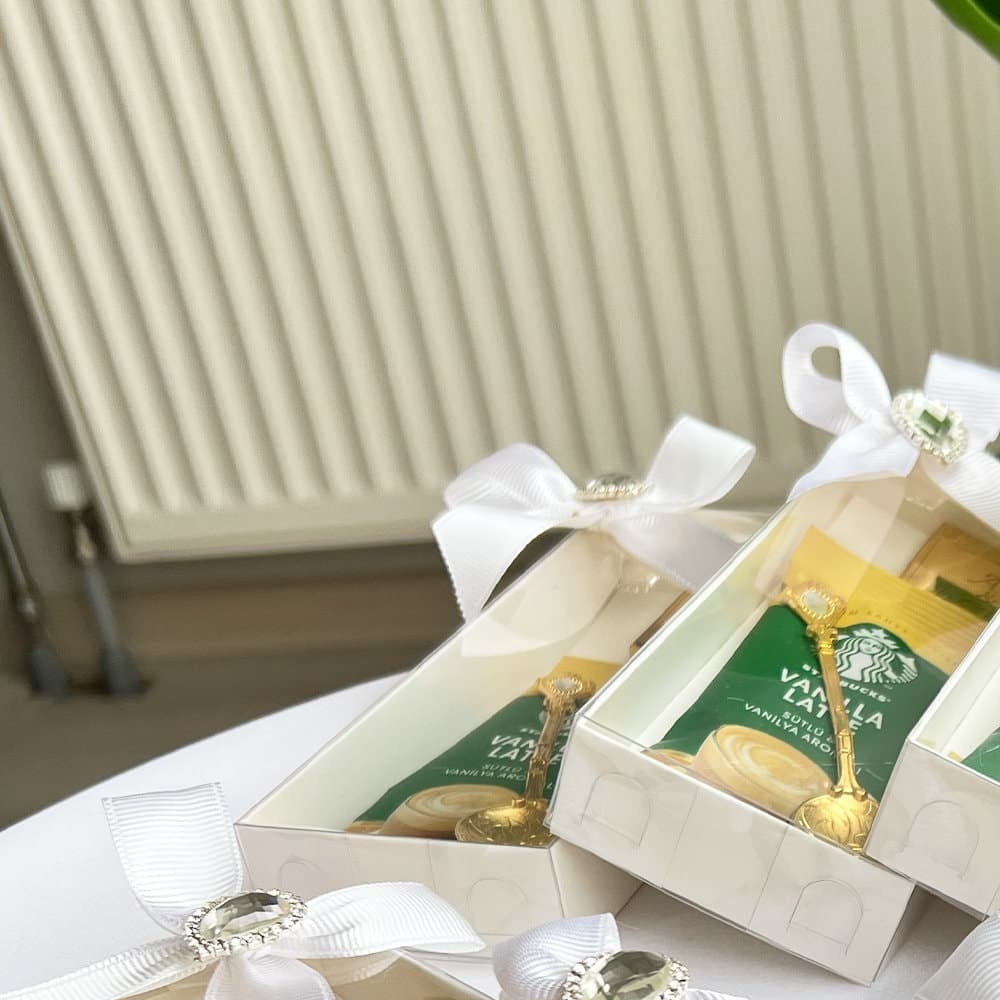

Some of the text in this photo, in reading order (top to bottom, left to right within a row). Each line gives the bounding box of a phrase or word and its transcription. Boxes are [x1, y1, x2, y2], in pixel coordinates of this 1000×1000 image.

[780, 667, 884, 730] VANLLA
[802, 664, 885, 703] STBUCKS
[782, 687, 864, 736] LATE
